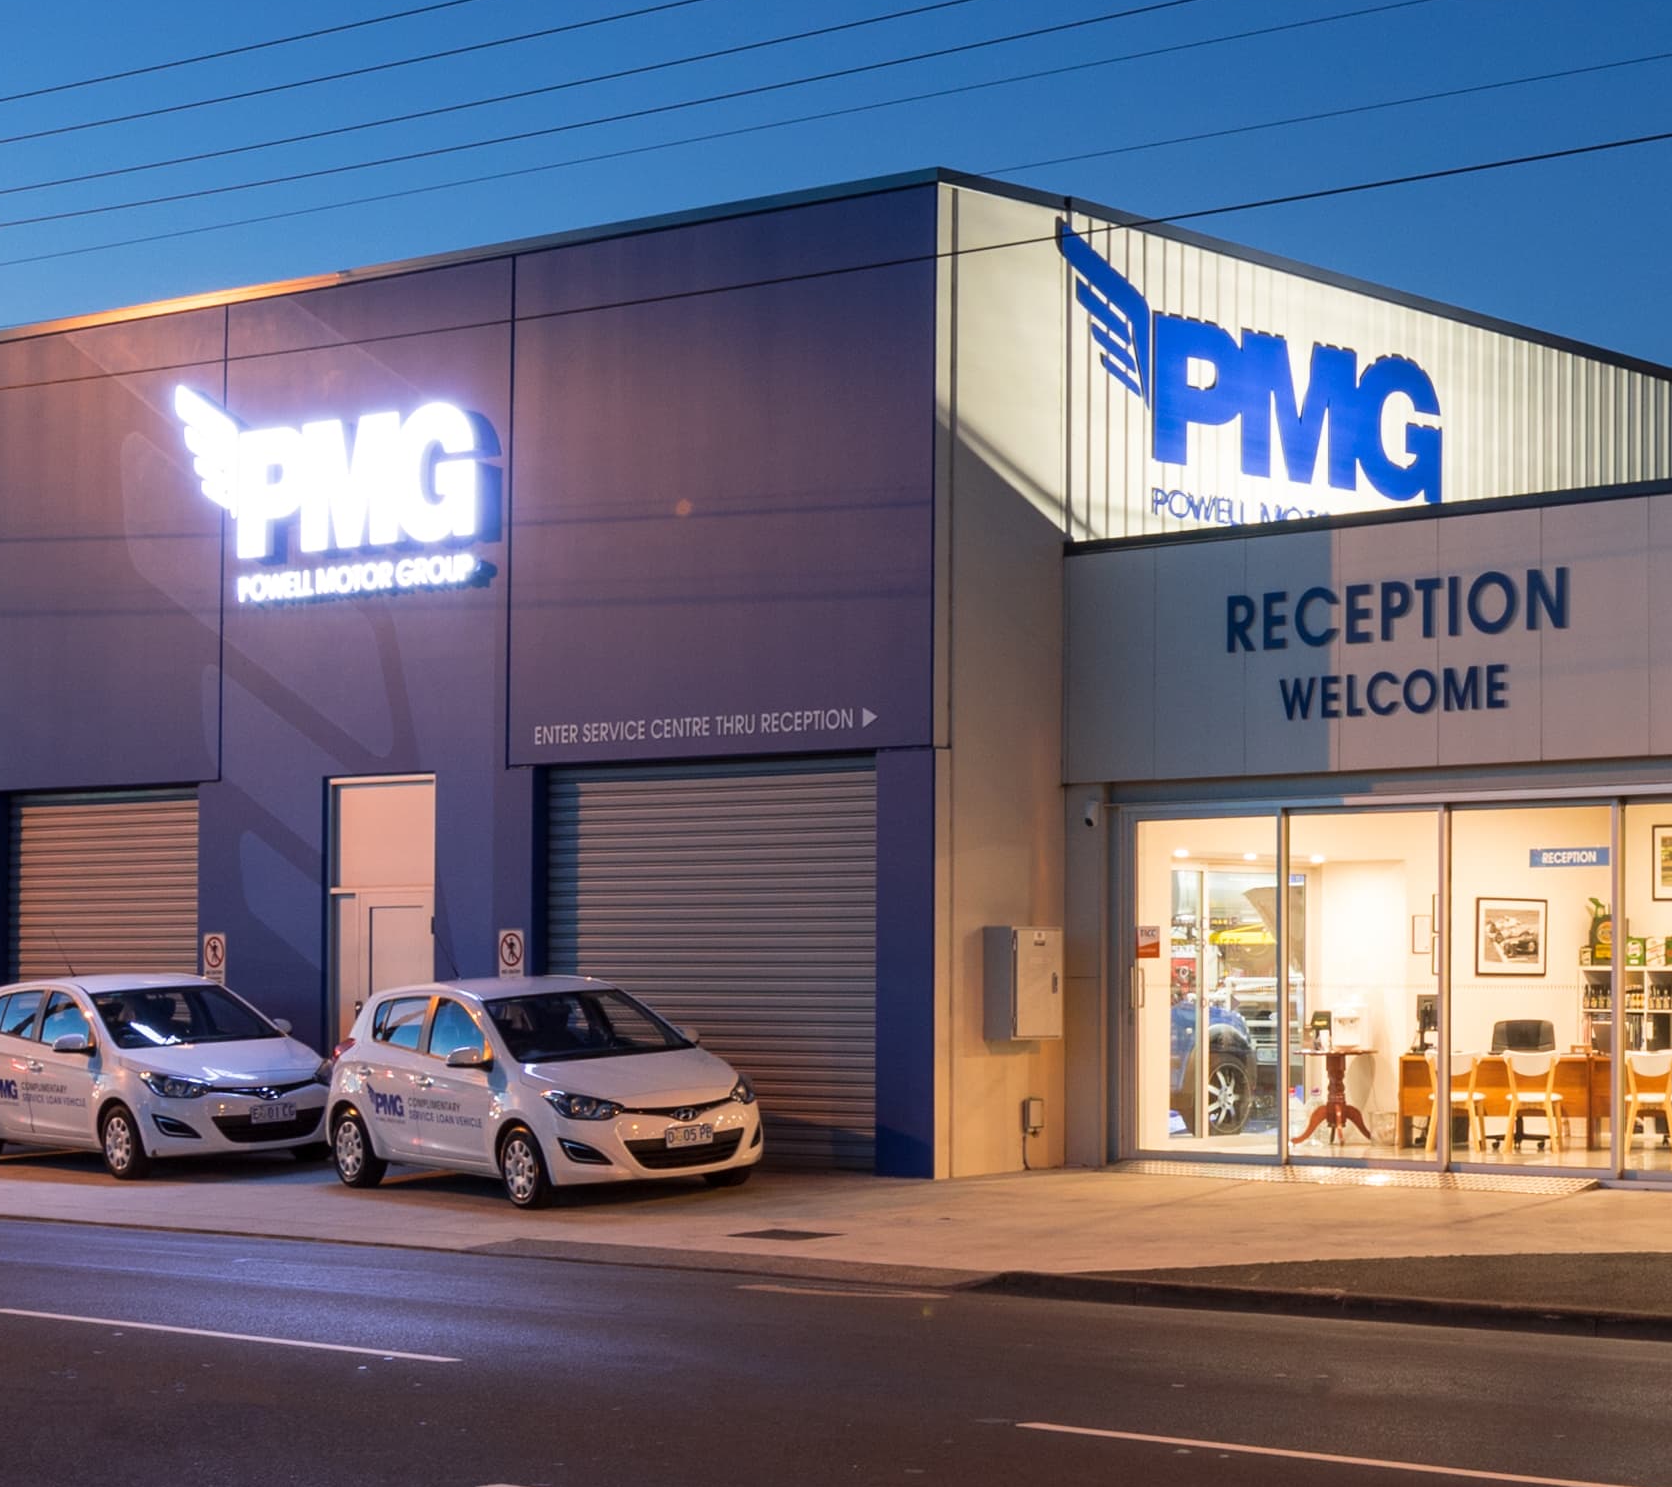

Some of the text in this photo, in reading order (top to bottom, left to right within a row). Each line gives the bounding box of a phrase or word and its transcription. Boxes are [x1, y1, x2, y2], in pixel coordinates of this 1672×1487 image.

[1152, 310, 1442, 505] PMG
[237, 401, 476, 560] PMG
[1151, 487, 1245, 527] POWELL
[237, 553, 476, 603] POWELL MOTOR GROUP
[1226, 566, 1571, 653] RECEPTION
[1279, 663, 1510, 722] WELCOME
[534, 708, 854, 746] ENTER SERVICE CENTRE THRU RECEPTION
[1541, 850, 1598, 865] RECEPTION
[374, 1092, 405, 1117] PMG
[436, 1113, 455, 1124] LOAN
[456, 1115, 483, 1129] VEHICLE
